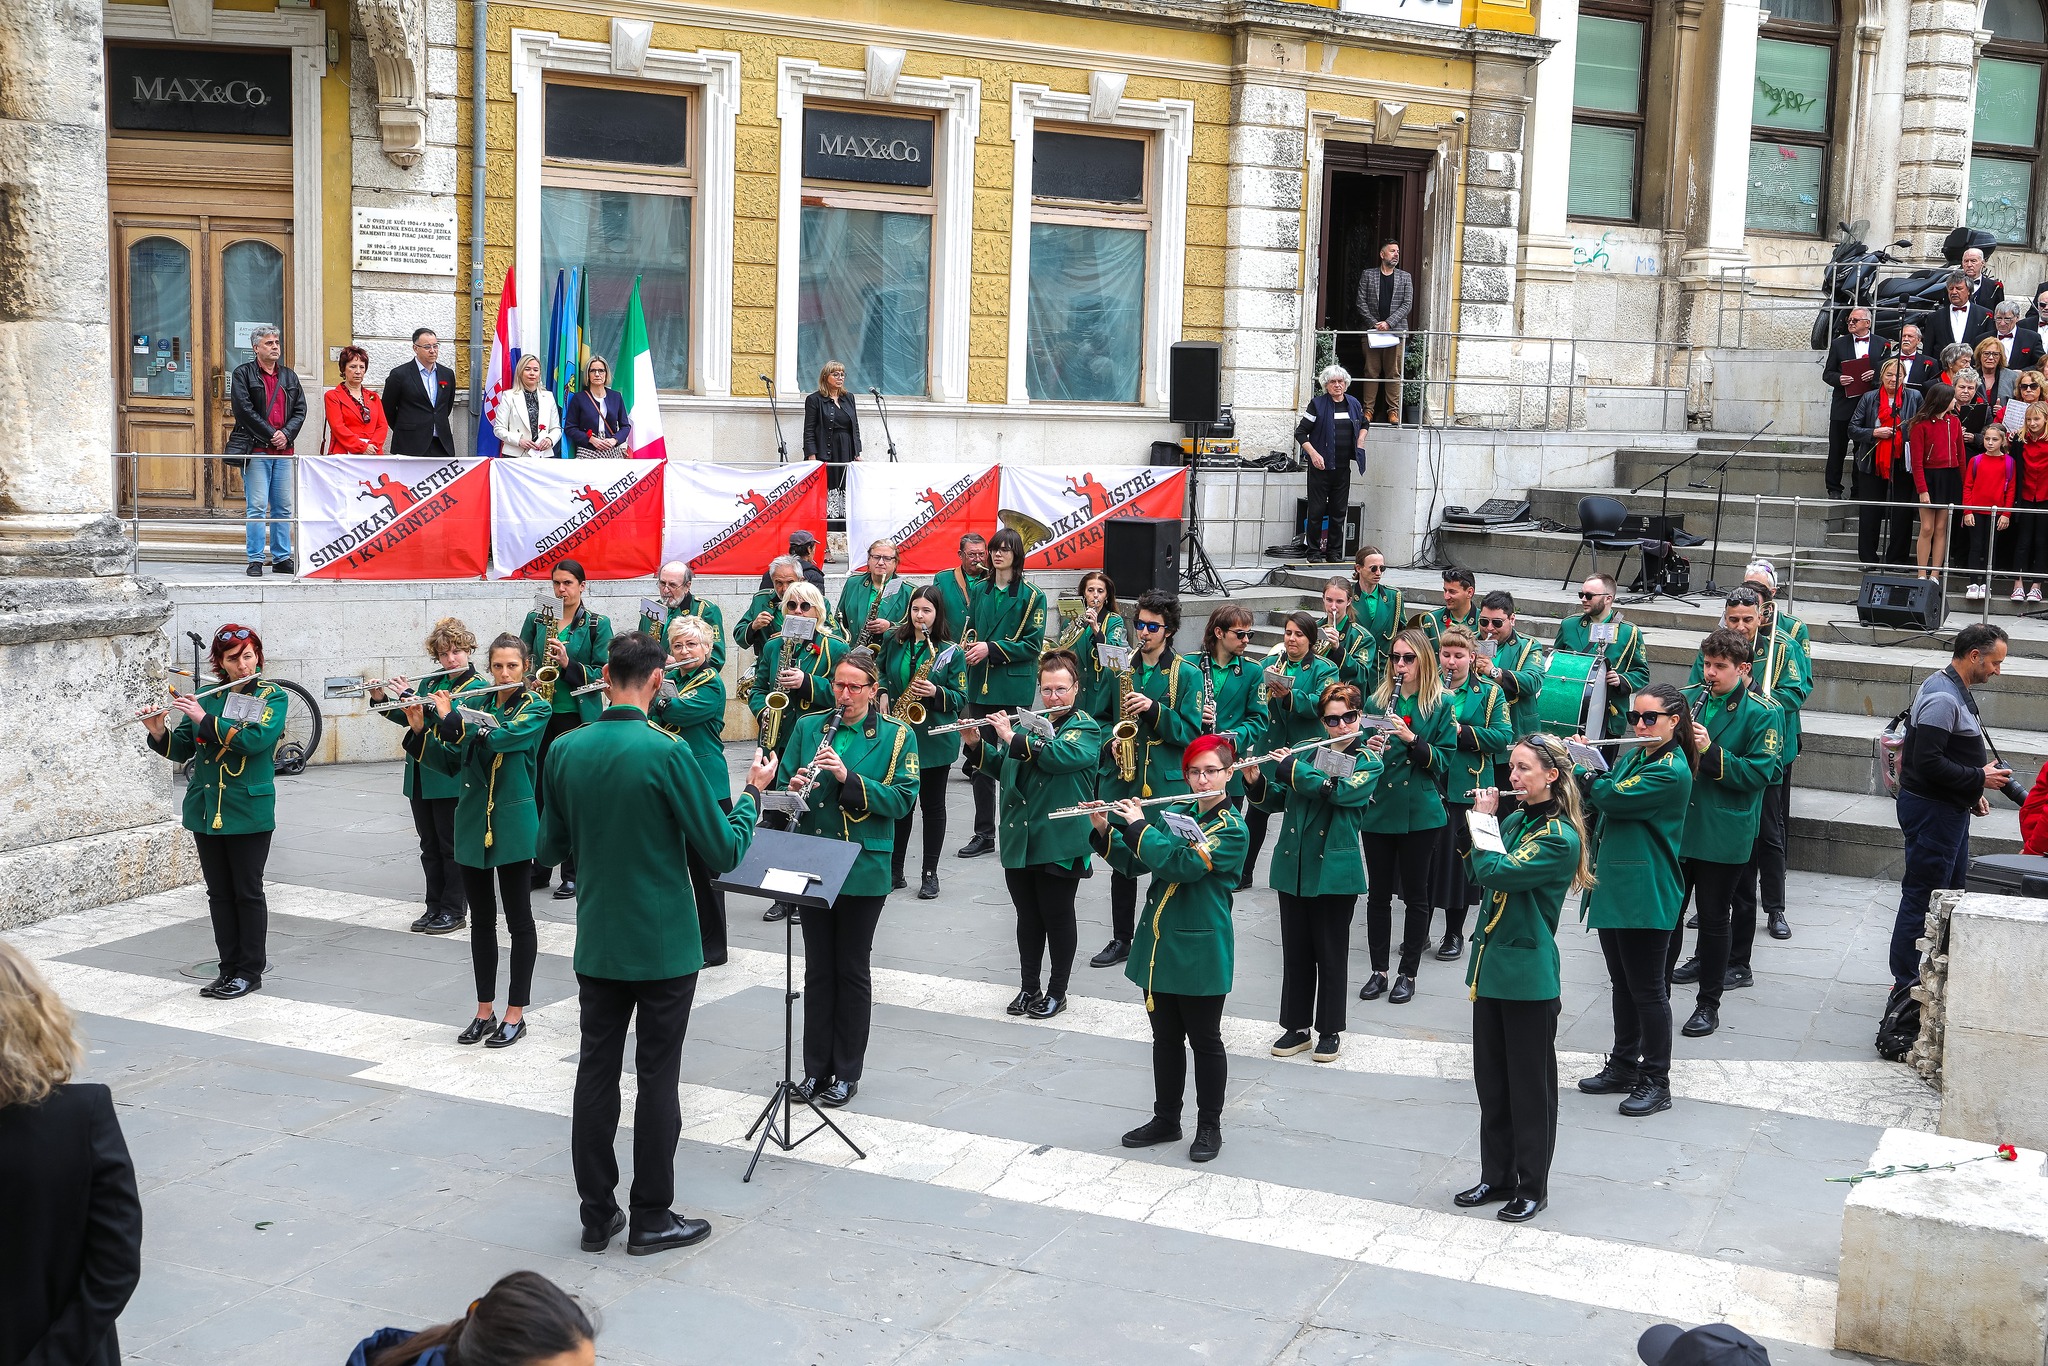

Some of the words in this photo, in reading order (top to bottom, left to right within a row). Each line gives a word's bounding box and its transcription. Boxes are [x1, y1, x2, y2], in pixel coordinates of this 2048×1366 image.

[309, 504, 397, 568] SINDIKAT
[409, 459, 465, 501] ISTRE
[535, 504, 596, 554] SINDIKAT
[603, 471, 638, 504] ISTRE
[702, 507, 758, 552] SINDIKAT
[766, 475, 798, 505] ISTRE
[937, 472, 995, 526] DALMACIJE
[942, 474, 974, 504] ISTRE
[1108, 469, 1156, 506] ISTRE
[346, 555, 359, 569] I
[356, 492, 458, 563] KVARNERA
[521, 525, 595, 577] KVARNERA
[1044, 551, 1054, 567] I
[1888, 752, 1896, 779] MUSTO
